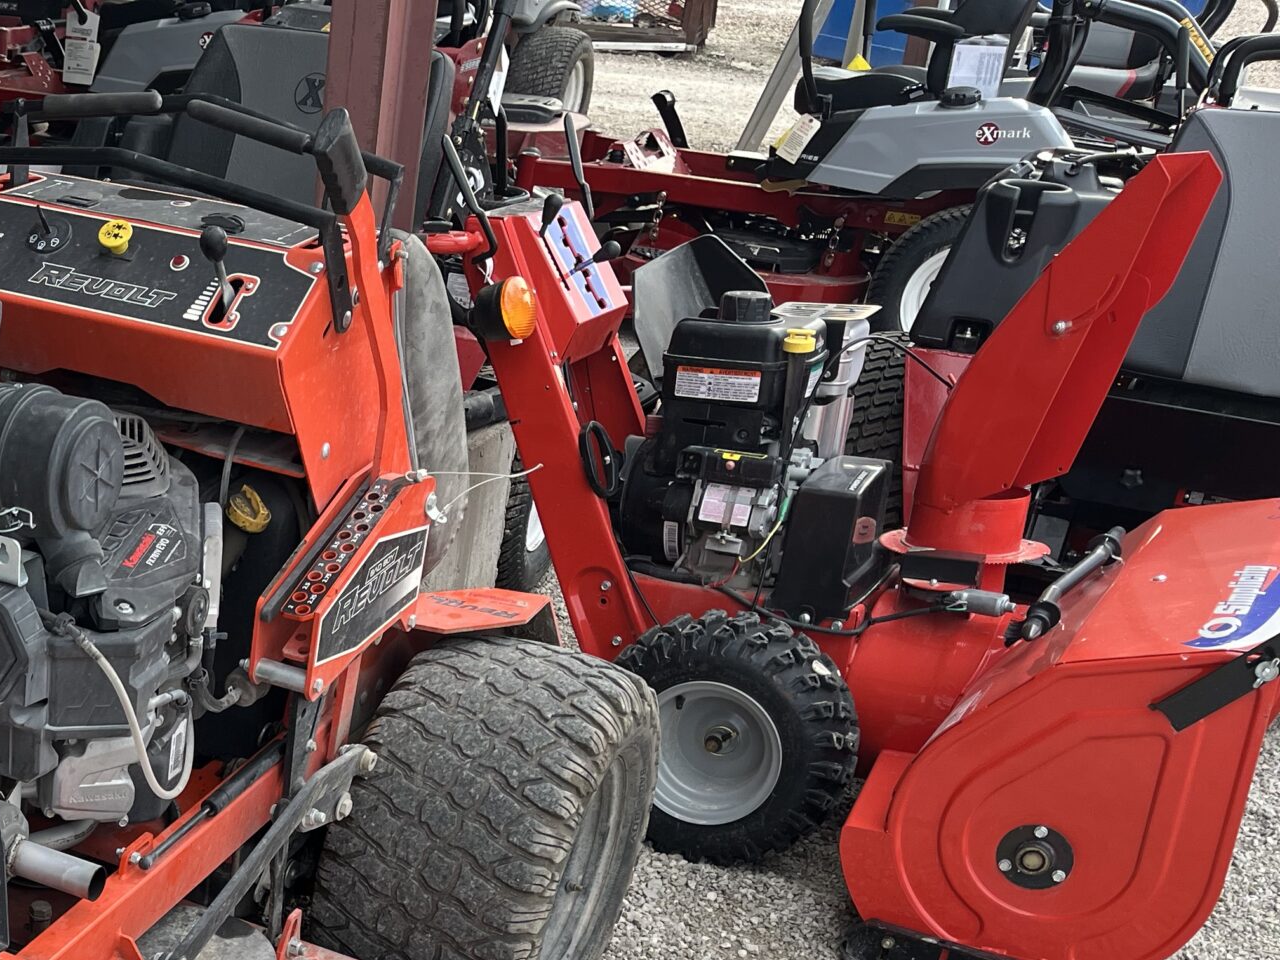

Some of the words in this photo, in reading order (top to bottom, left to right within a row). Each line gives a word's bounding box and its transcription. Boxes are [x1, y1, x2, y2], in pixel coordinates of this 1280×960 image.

[975, 122, 1031, 144] eXmark
[801, 153, 819, 162] RIES
[28, 261, 178, 308] REVOLT
[332, 541, 423, 634] REVOLT
[1213, 565, 1278, 615] Simplicity
